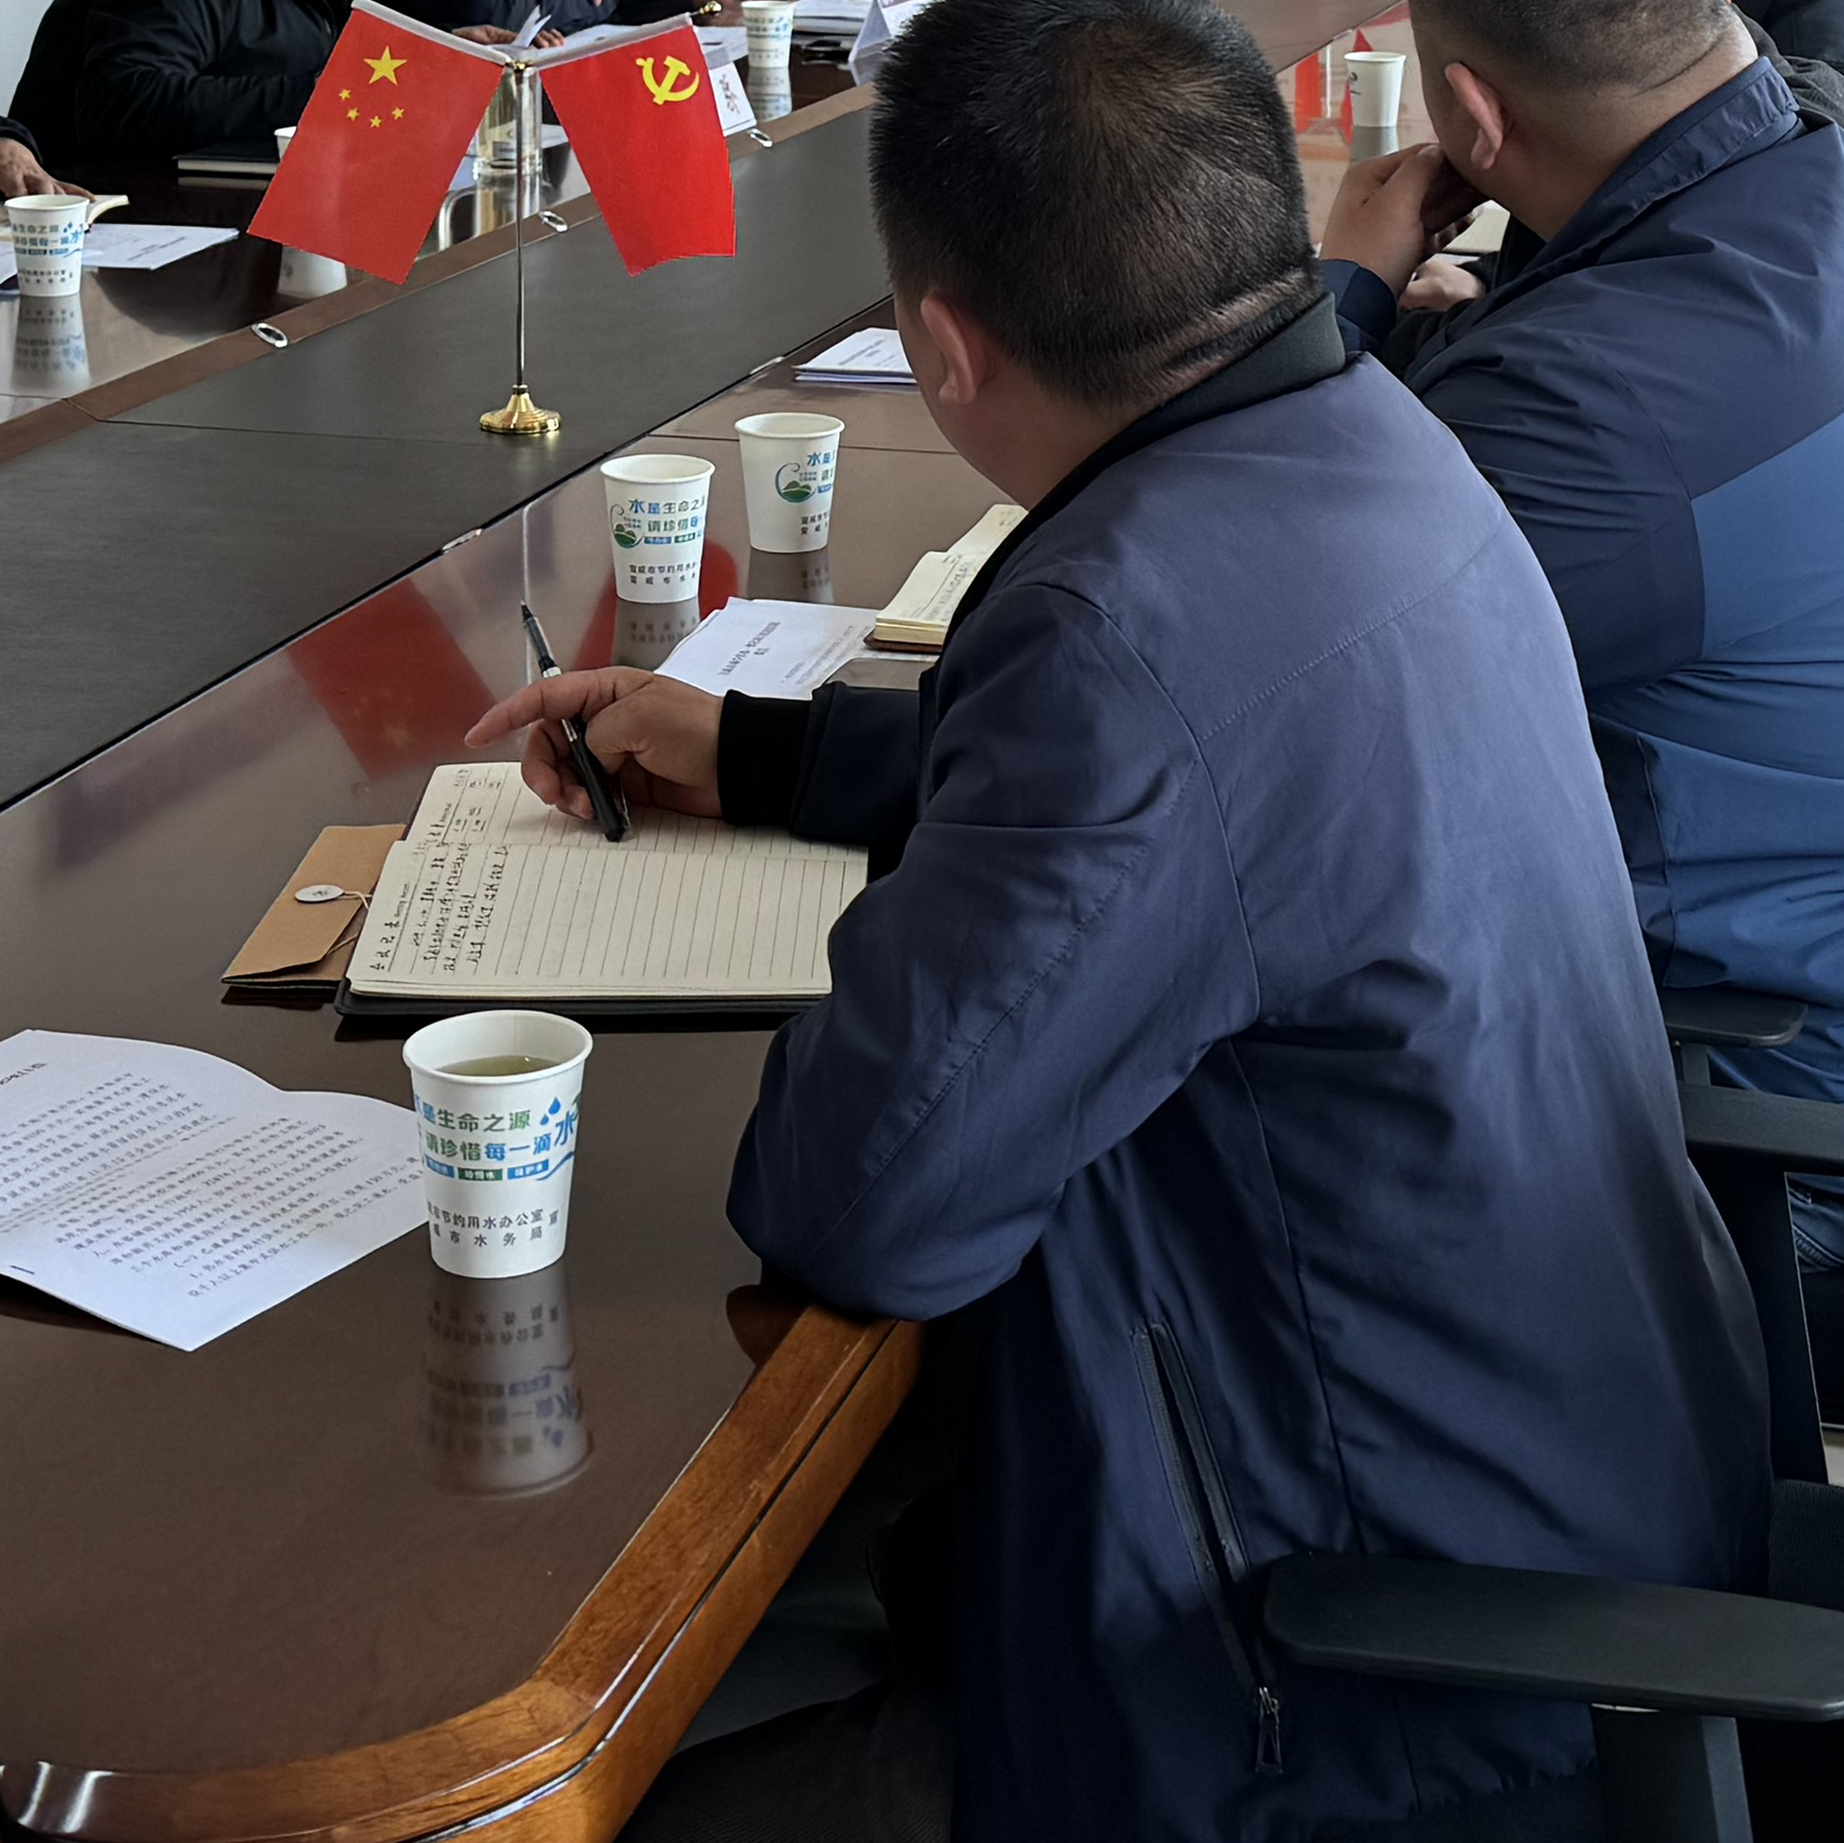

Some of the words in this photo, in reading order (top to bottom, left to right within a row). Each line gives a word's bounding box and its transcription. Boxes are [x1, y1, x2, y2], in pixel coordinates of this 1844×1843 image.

[807, 449, 836, 468] 水是
[628, 494, 705, 516] 水是生命之
[425, 1131, 552, 1162] 请珍惜每一滴
